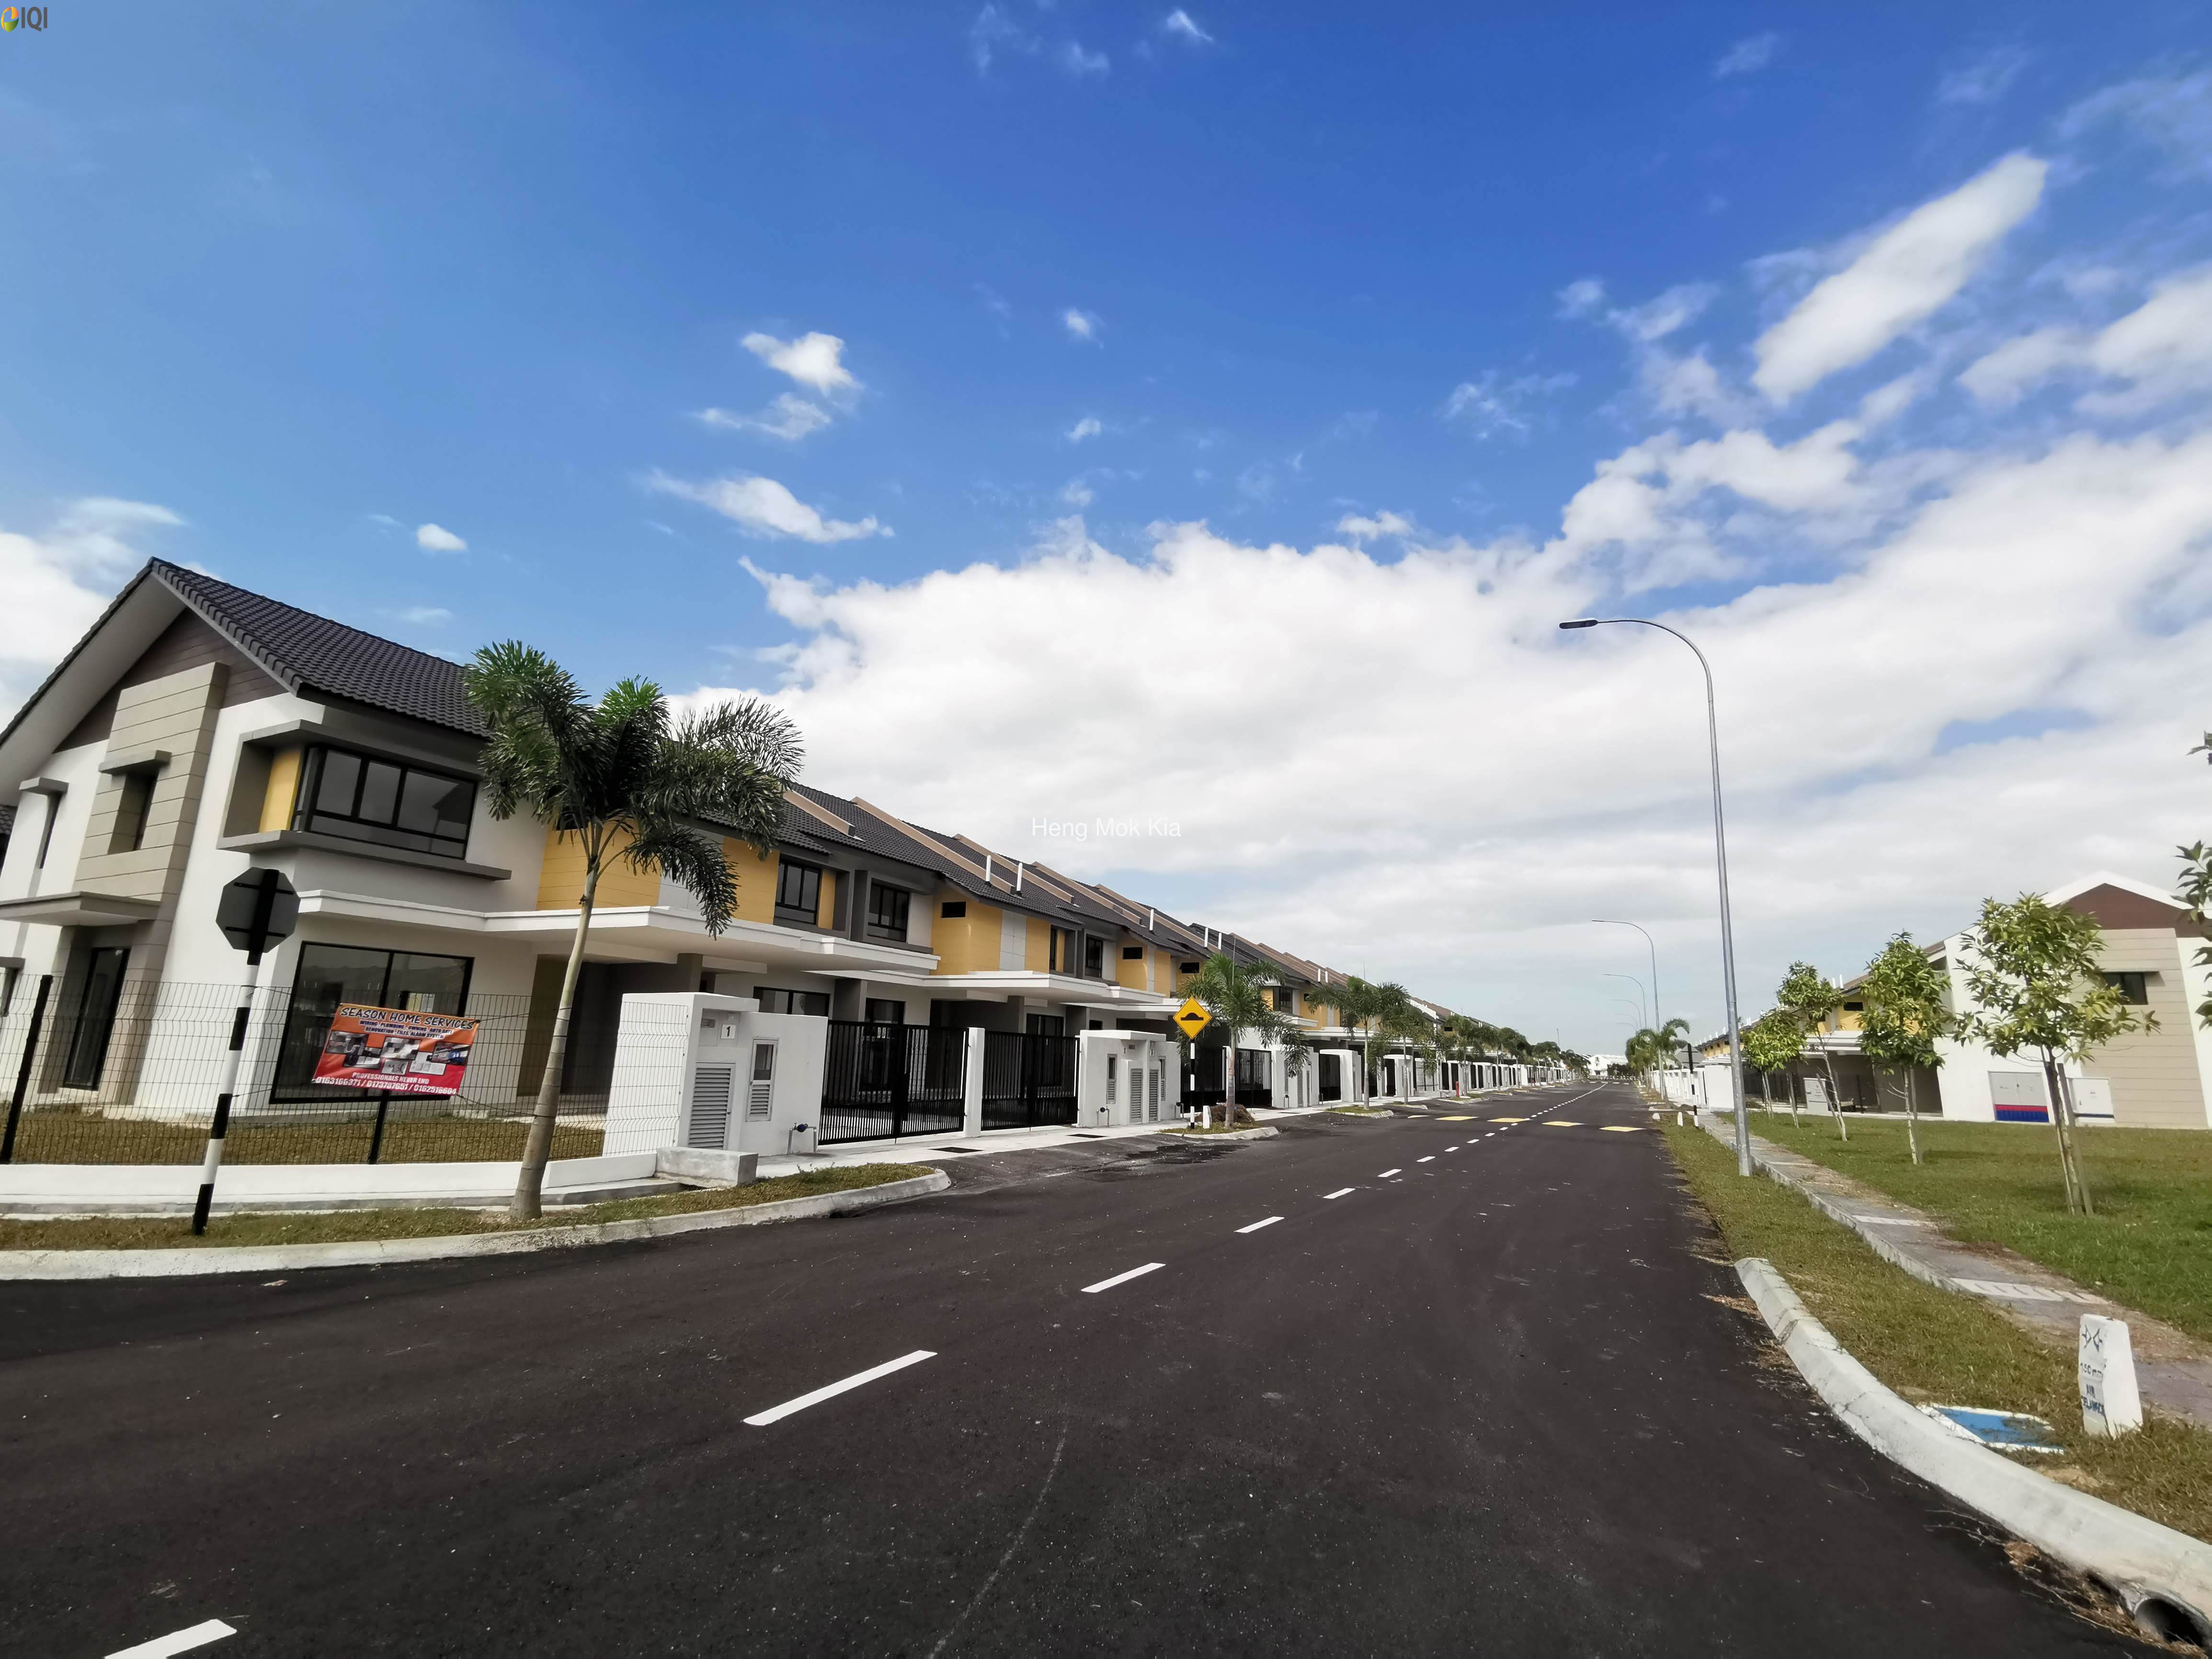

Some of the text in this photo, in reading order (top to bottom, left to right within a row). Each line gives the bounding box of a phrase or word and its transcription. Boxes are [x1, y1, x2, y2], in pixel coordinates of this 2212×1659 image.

[341, 1007, 474, 1029] SEASON HOME SERVICES
[726, 1026, 731, 1037] 1
[352, 1072, 399, 1081] PROFESSIONALS
